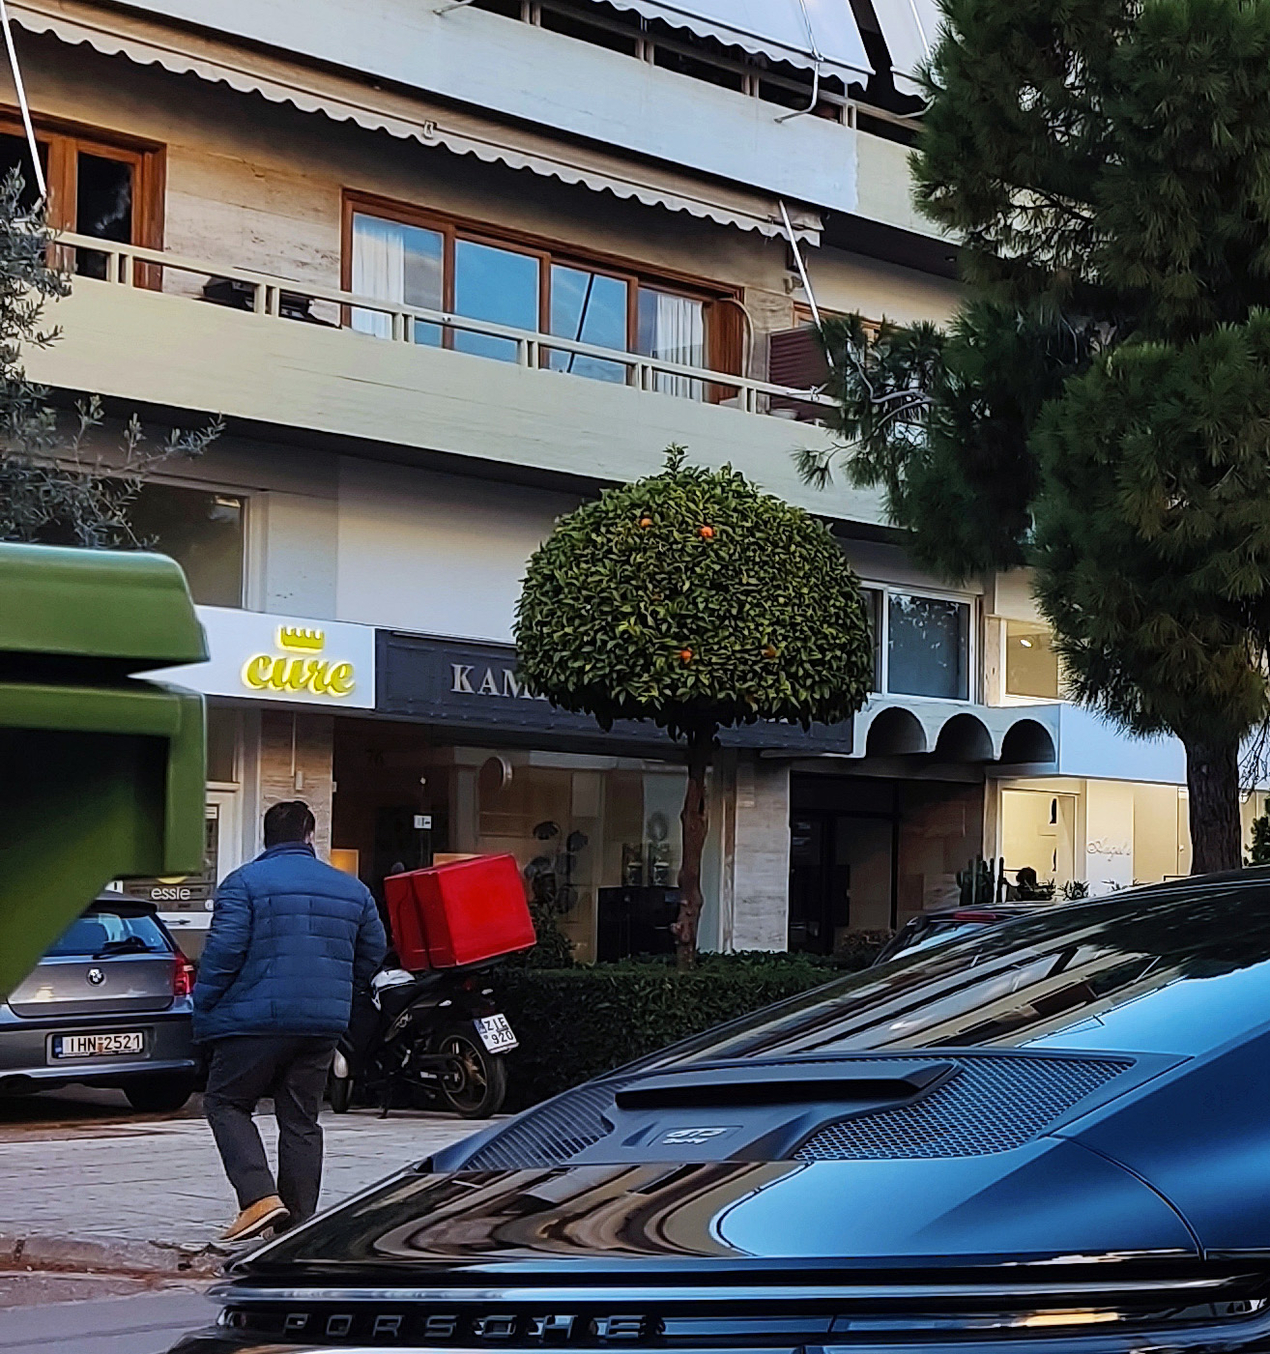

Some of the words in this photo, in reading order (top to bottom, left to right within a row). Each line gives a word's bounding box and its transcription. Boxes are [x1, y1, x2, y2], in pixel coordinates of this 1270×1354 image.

[245, 654, 355, 695] cure
[450, 663, 549, 701] KAM
[491, 1030, 514, 1044] 920
[281, 1313, 647, 1341] PORSCHE
